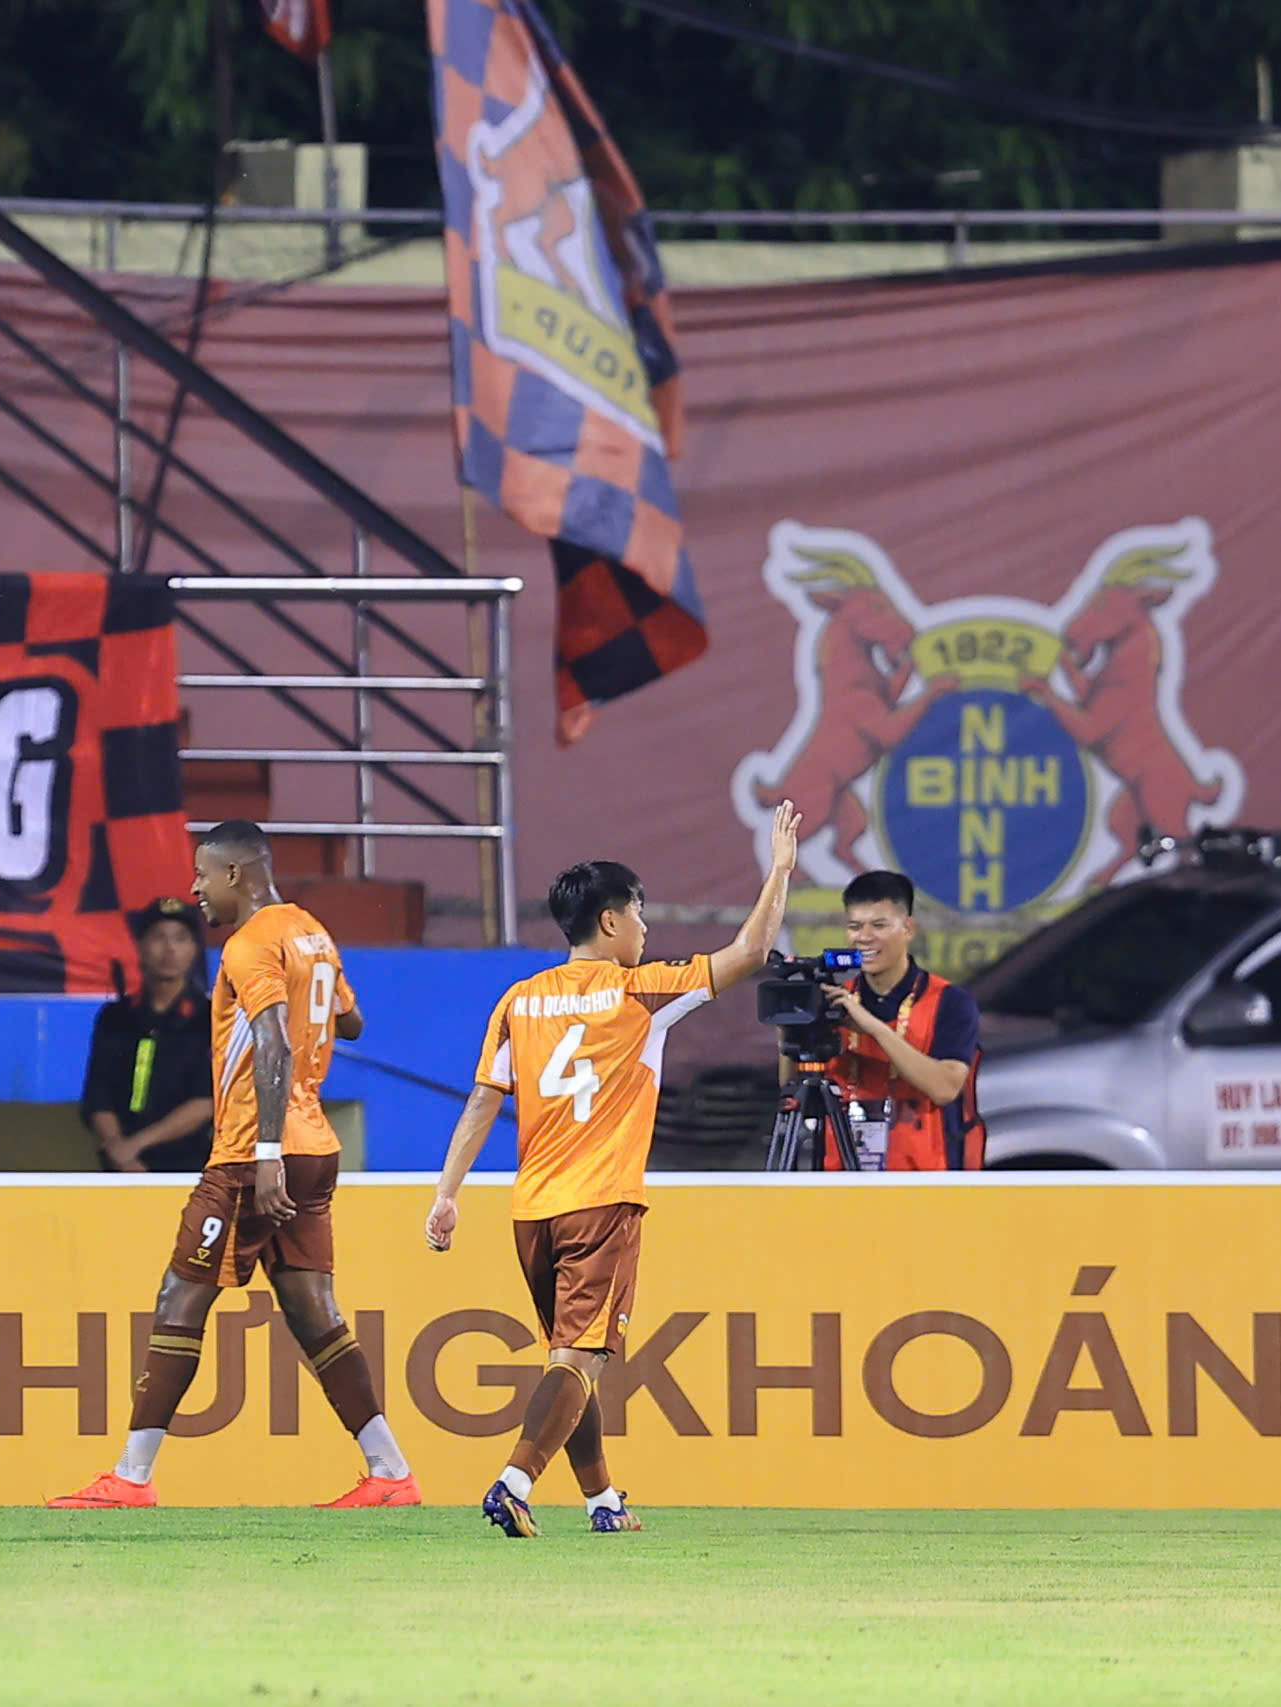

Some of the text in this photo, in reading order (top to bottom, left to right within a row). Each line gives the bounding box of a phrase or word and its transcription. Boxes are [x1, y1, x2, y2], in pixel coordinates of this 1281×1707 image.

[933, 630, 1033, 666] 1822
[539, 1023, 600, 1123] 4
[201, 1216, 223, 1248] 9
[603, 1265, 1281, 1439] KHOÁN
